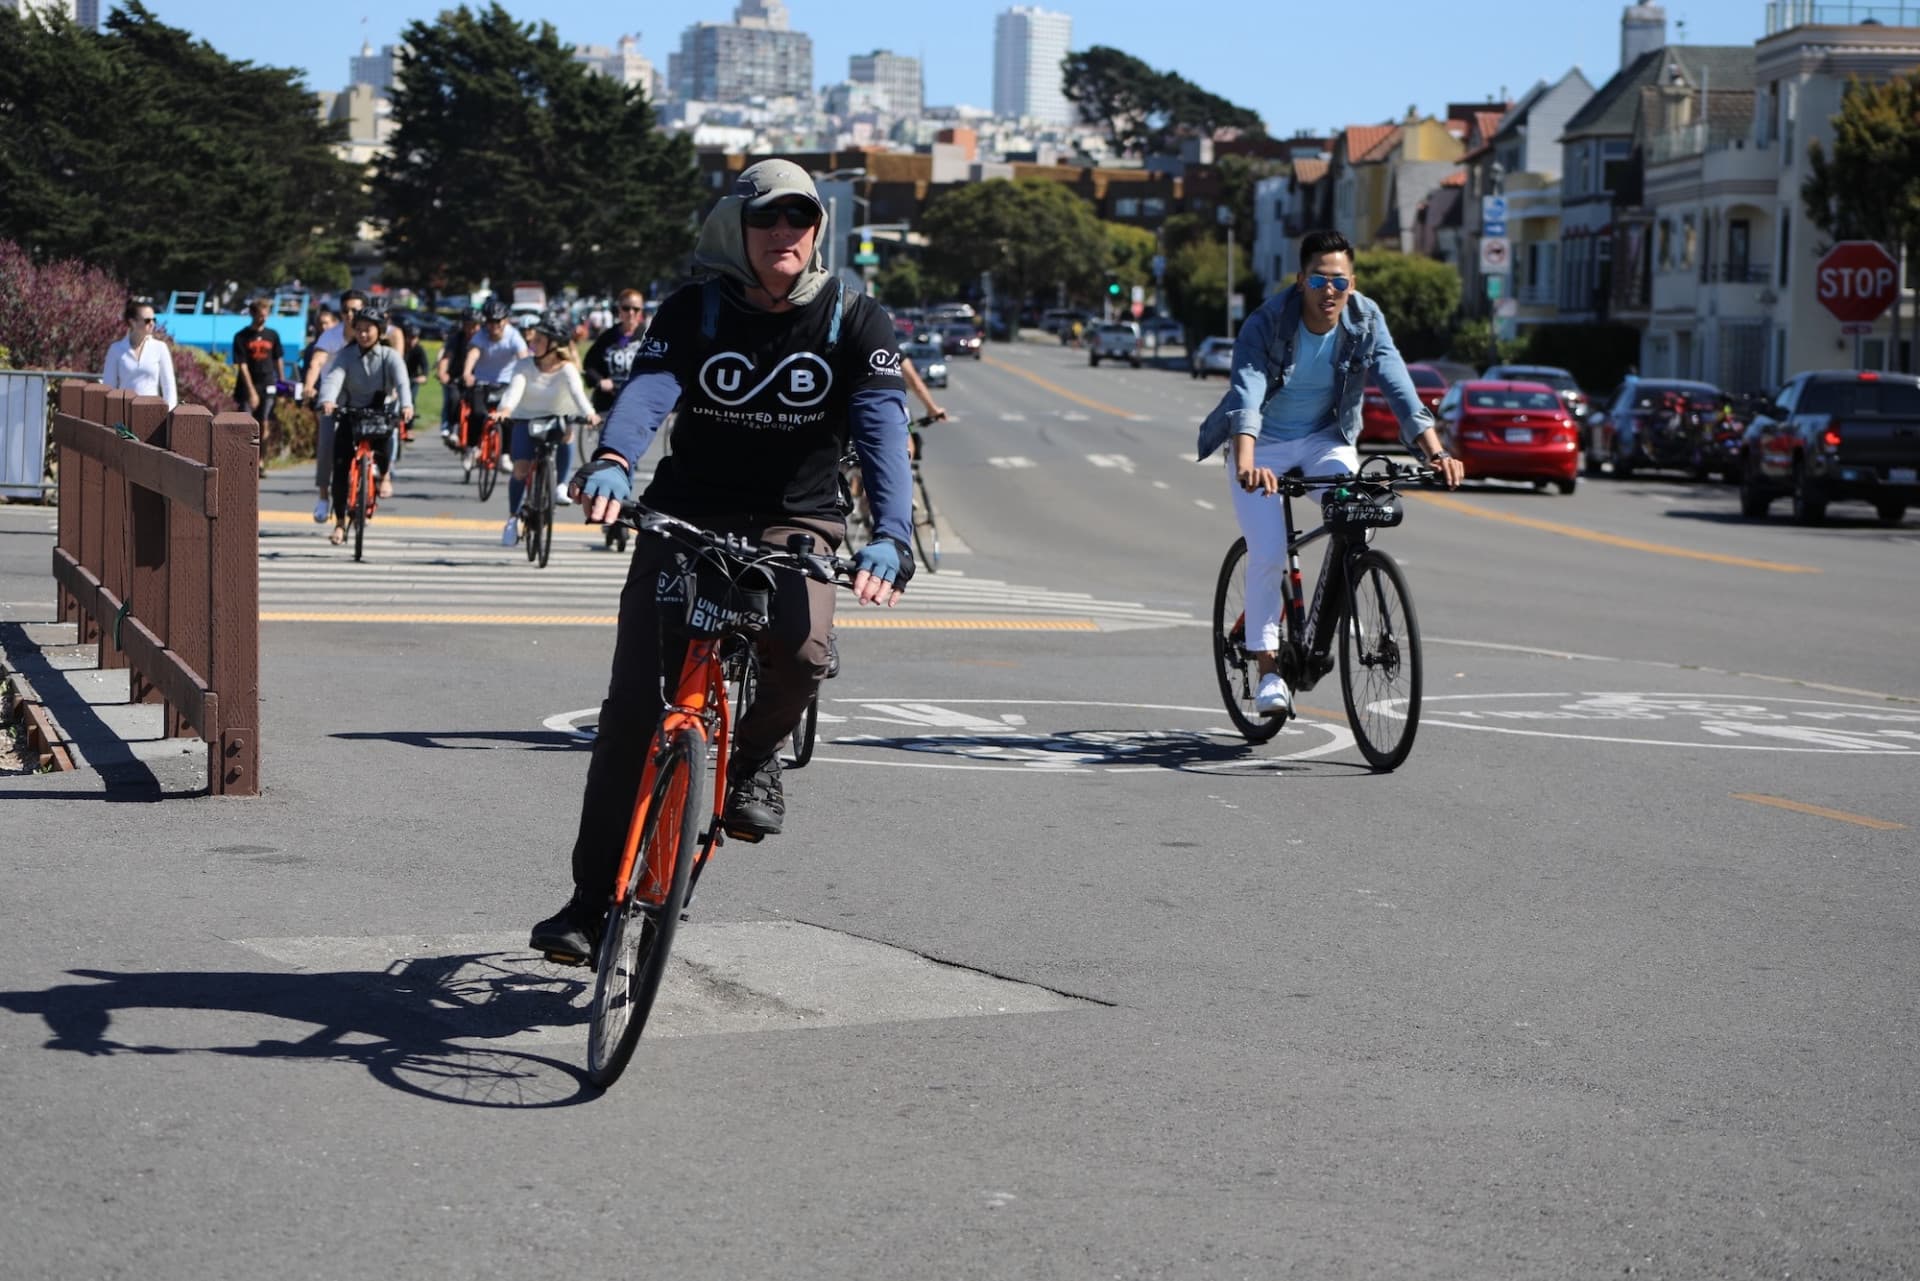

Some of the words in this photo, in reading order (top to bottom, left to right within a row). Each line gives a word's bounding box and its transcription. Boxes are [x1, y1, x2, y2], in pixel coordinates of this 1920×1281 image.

[1821, 267, 1893, 298] STOP
[876, 354, 887, 365] U
[716, 369, 741, 392] U
[790, 369, 816, 393] B
[692, 407, 772, 424] UNLIMITED
[778, 411, 825, 425] BIKING
[1346, 512, 1393, 522] BIKING
[697, 597, 769, 625] UNLIMIED
